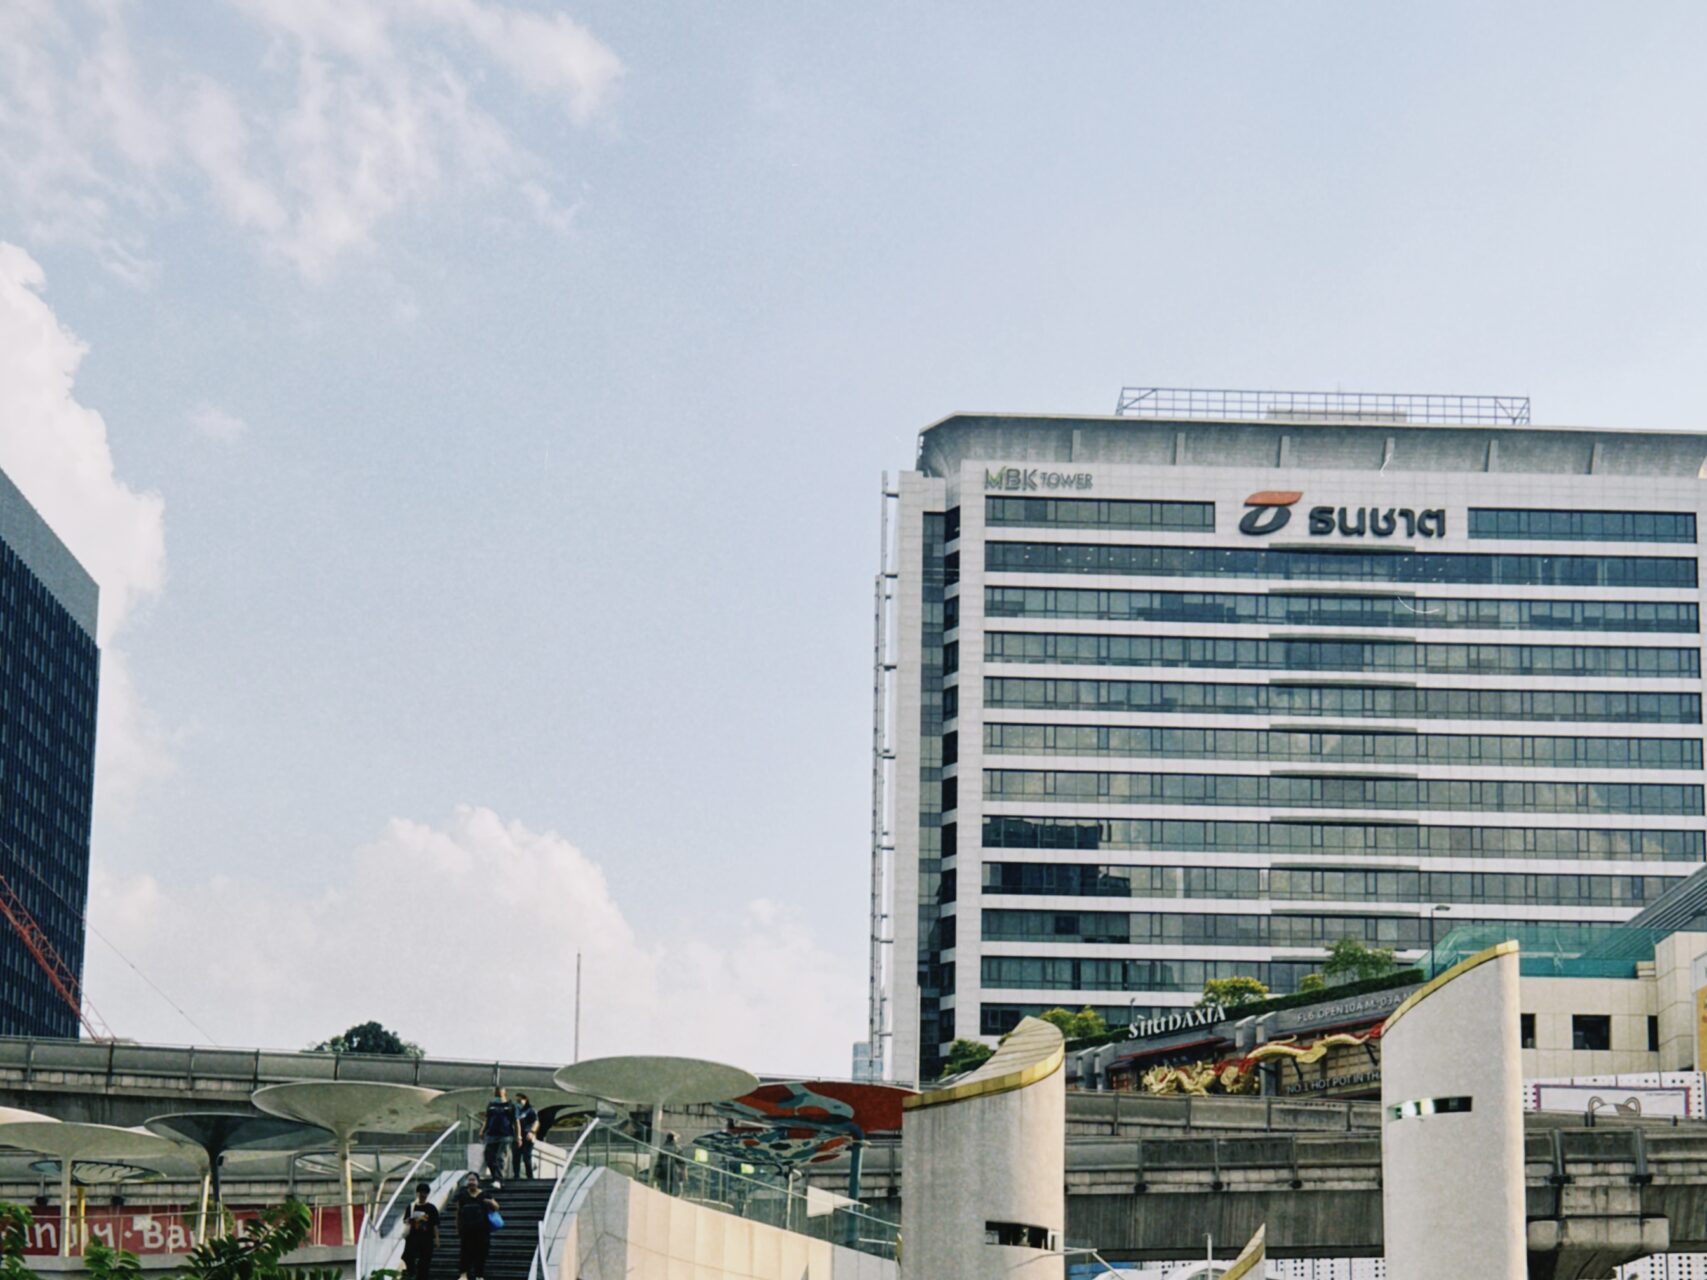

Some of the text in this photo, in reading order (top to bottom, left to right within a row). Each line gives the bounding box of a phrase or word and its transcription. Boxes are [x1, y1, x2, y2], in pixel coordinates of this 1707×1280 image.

[984, 465, 1094, 491] MBK TOWER
[1307, 505, 1447, 540] ธนชาต
